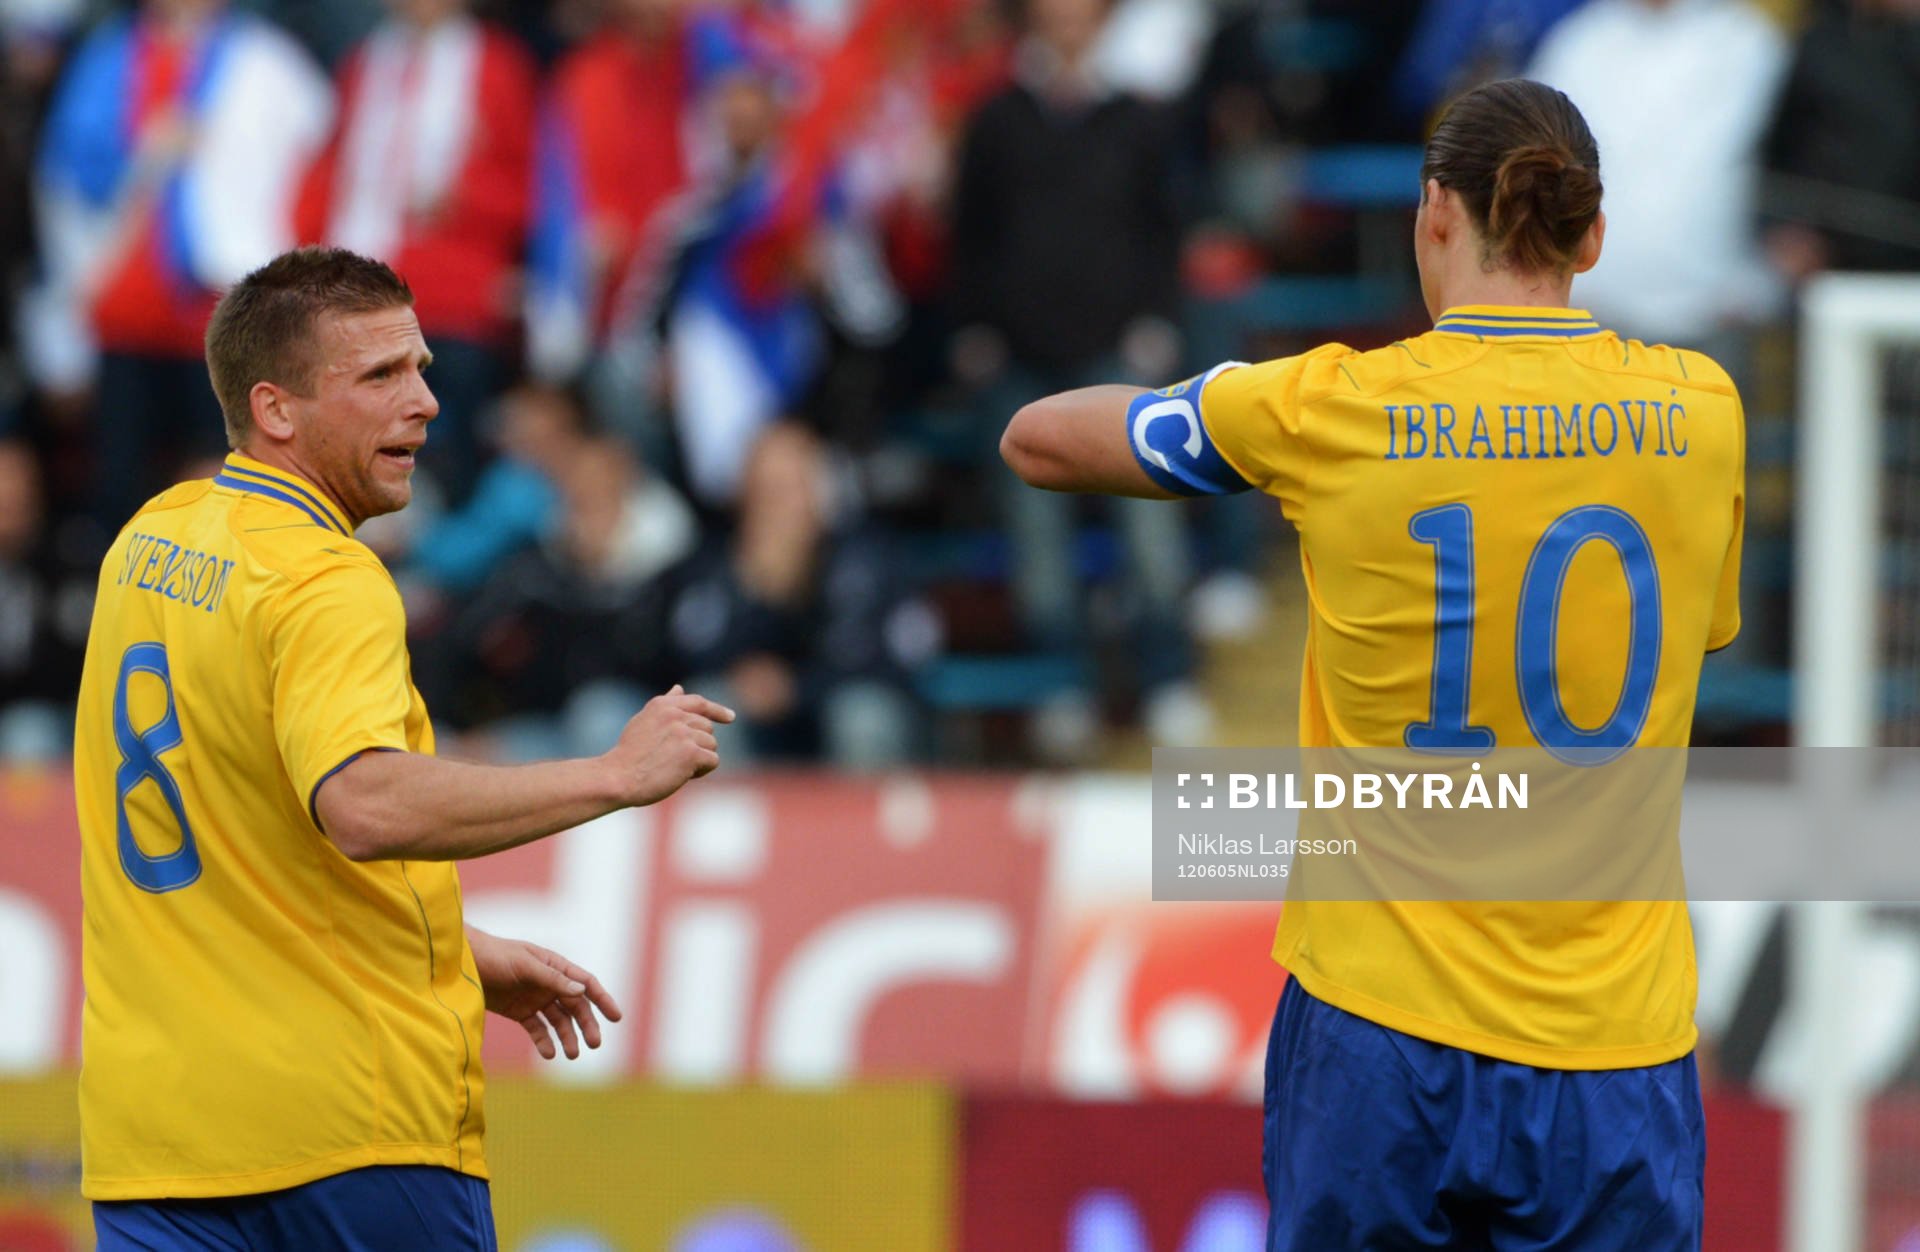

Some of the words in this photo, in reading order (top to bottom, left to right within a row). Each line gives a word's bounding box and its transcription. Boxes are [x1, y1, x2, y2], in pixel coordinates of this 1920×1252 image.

[1133, 399, 1202, 473] C
[1383, 388, 1688, 460] IBRAHIMOVIĆ
[1403, 502, 1662, 768] 10
[112, 641, 203, 895] 8
